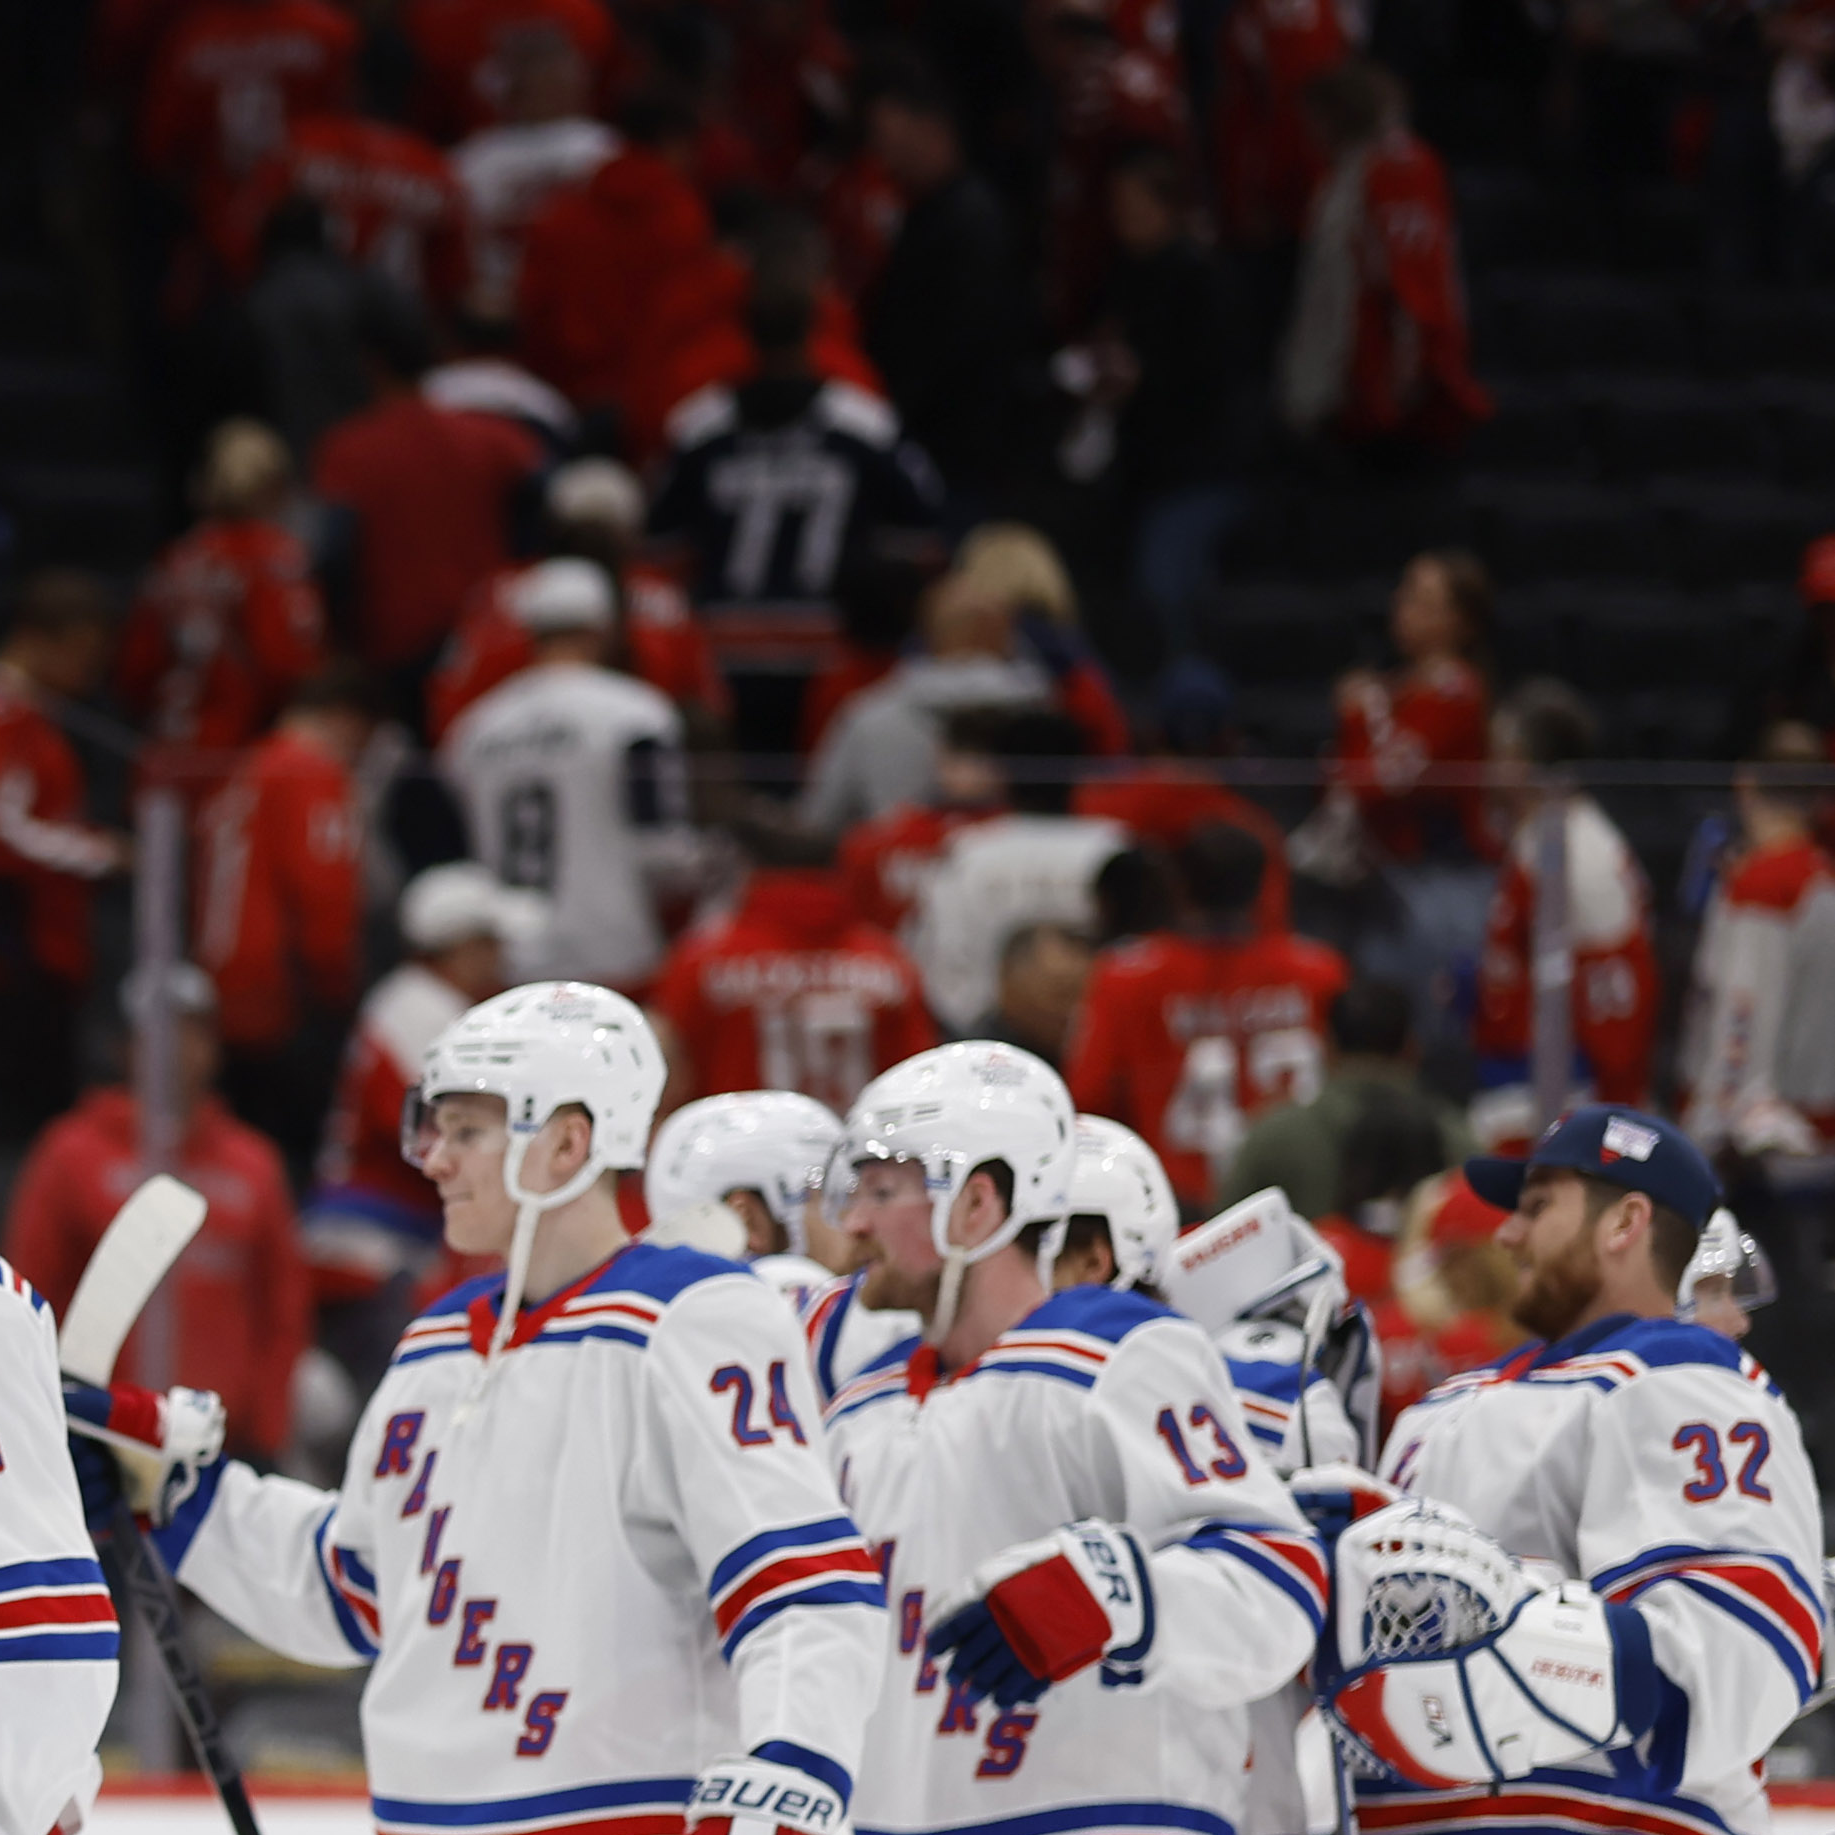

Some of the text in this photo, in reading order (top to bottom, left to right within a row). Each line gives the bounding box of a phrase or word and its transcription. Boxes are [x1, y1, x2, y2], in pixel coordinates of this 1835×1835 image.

[710, 1361, 808, 1447] 24
[1156, 1404, 1248, 1486] 13
[1671, 1421, 1773, 1504] 32
